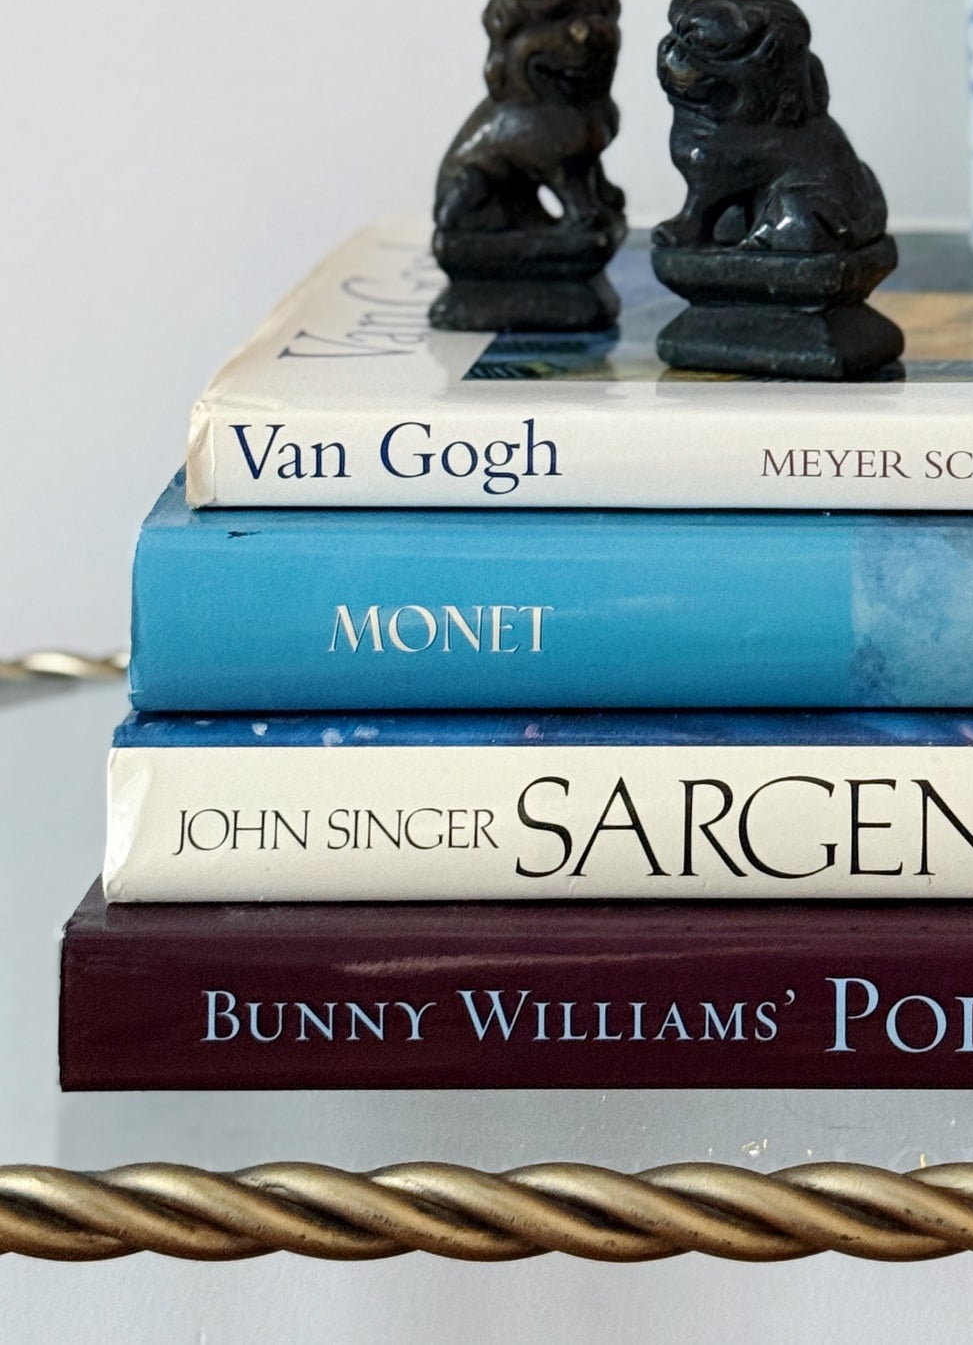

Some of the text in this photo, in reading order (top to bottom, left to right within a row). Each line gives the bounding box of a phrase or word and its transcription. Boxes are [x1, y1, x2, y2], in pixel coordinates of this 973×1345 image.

[228, 418, 562, 495] Van Gogh
[761, 448, 911, 479] MEYER
[328, 604, 554, 653] MONET
[173, 808, 311, 856] JOHN
[327, 807, 499, 850] SINGER
[201, 990, 437, 1042] BUNNY
